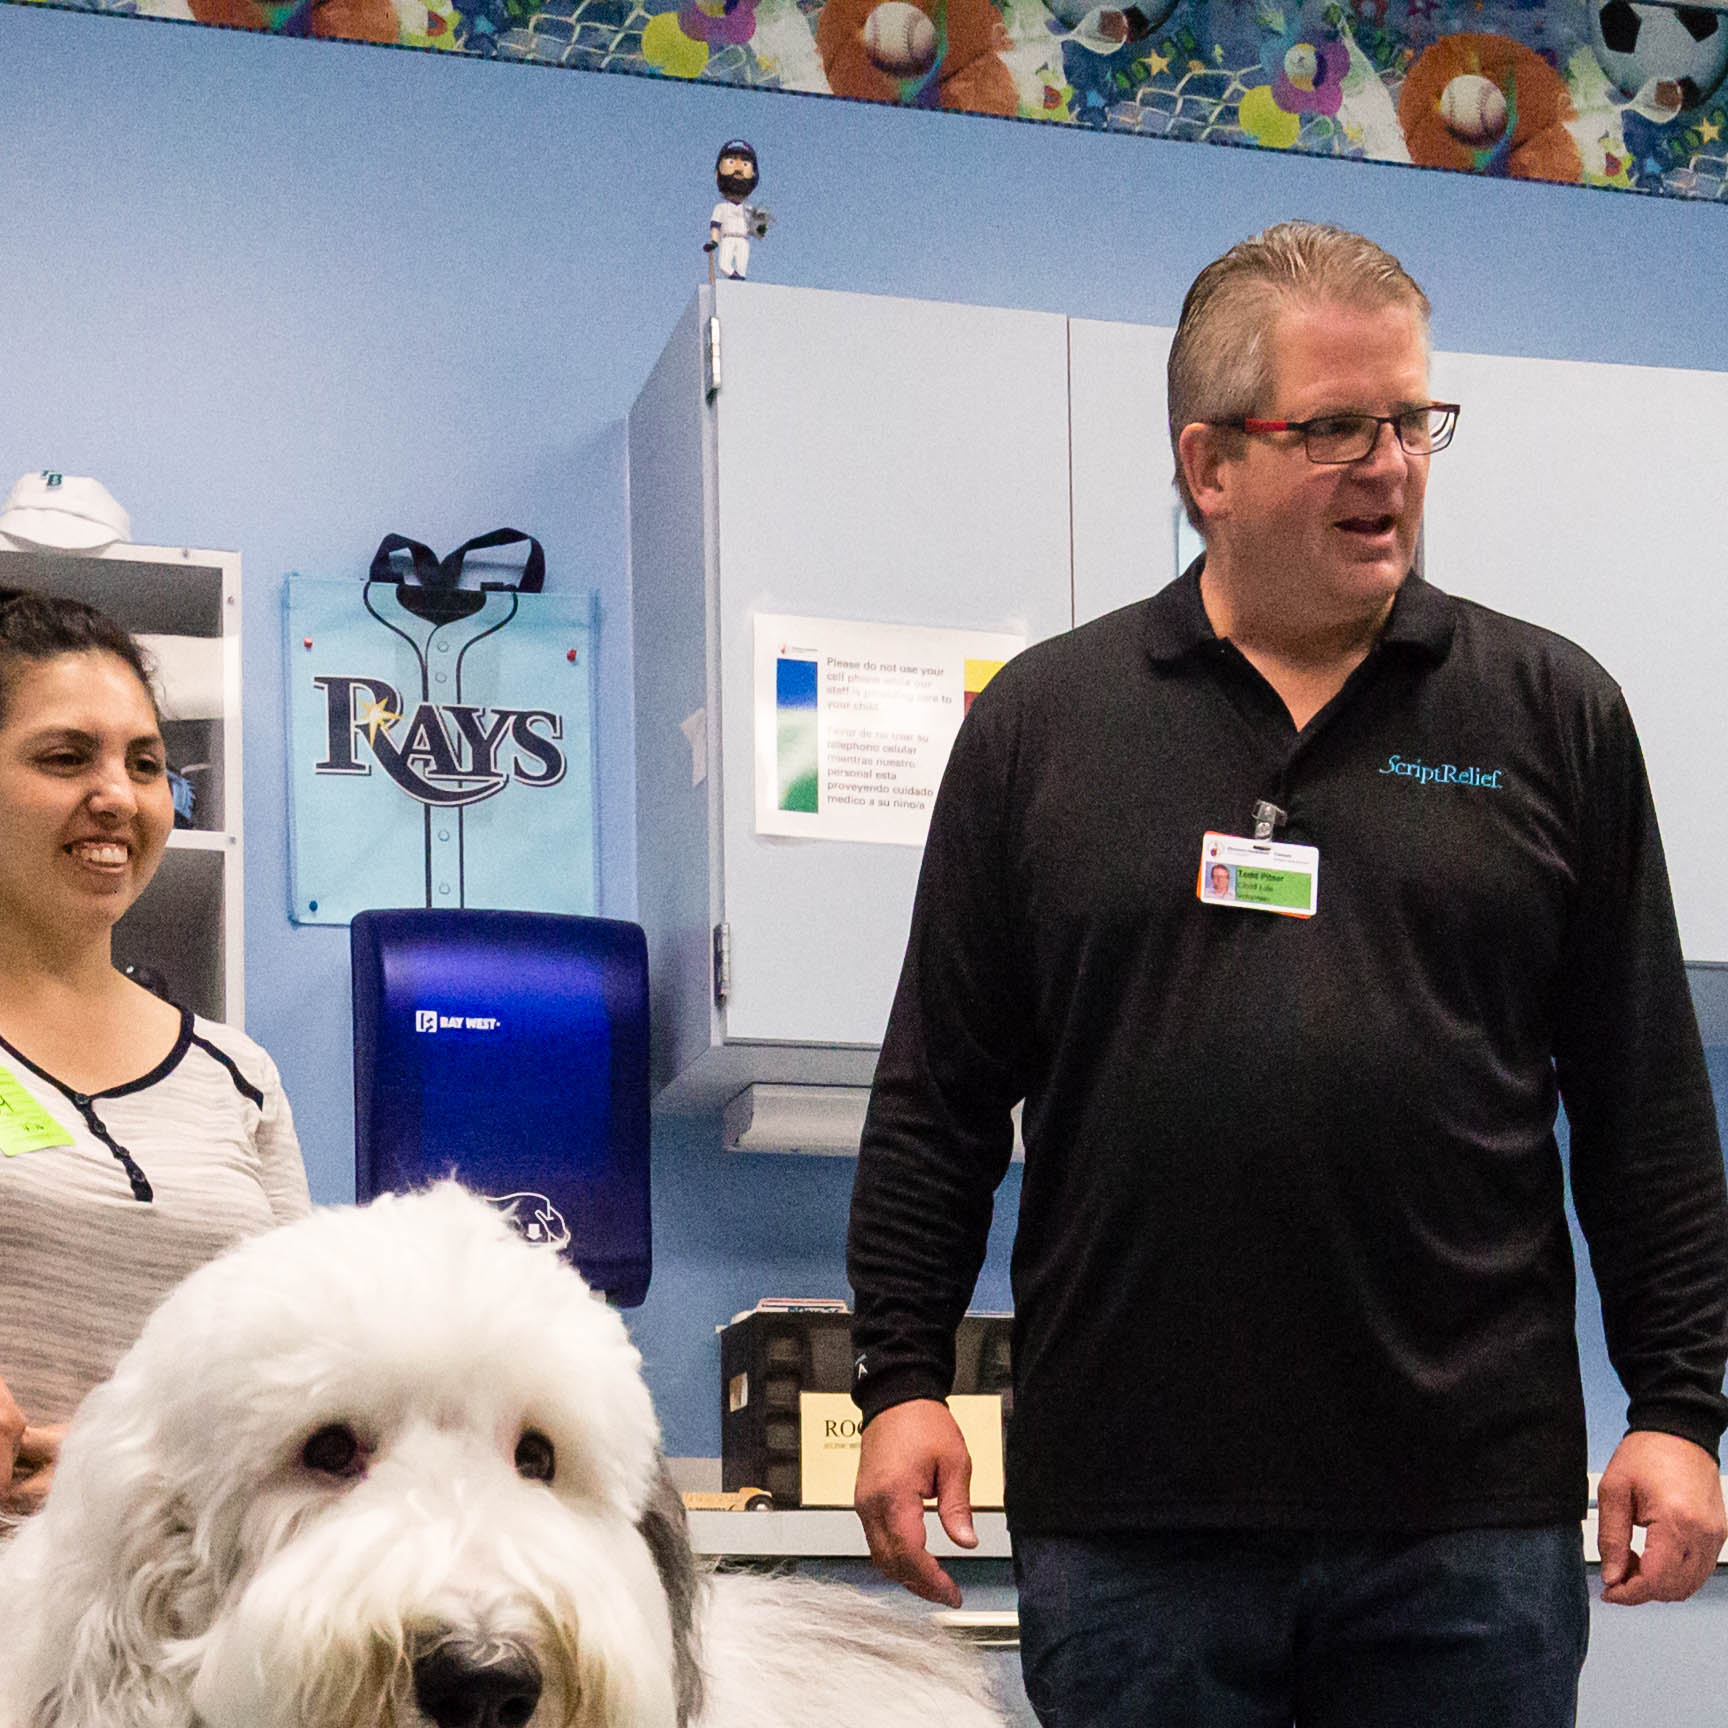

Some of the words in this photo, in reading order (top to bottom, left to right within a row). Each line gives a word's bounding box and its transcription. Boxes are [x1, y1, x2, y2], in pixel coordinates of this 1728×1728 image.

[827, 656, 860, 669] Please
[863, 660, 877, 671] do
[879, 663, 896, 673] not
[899, 665, 919, 675] use
[920, 668, 944, 678] your
[826, 671, 844, 682] cell
[941, 694, 953, 705] to
[313, 675, 568, 807] RAYS
[882, 743, 917, 755] celular
[876, 758, 917, 769] nuestro
[826, 767, 873, 779] personal
[875, 770, 897, 780] esta
[1378, 754, 1504, 789] ScriptRelief
[826, 781, 890, 794] proveyendo
[892, 785, 934, 797] cuidado
[826, 795, 866, 806] medico
[878, 799, 891, 808] su
